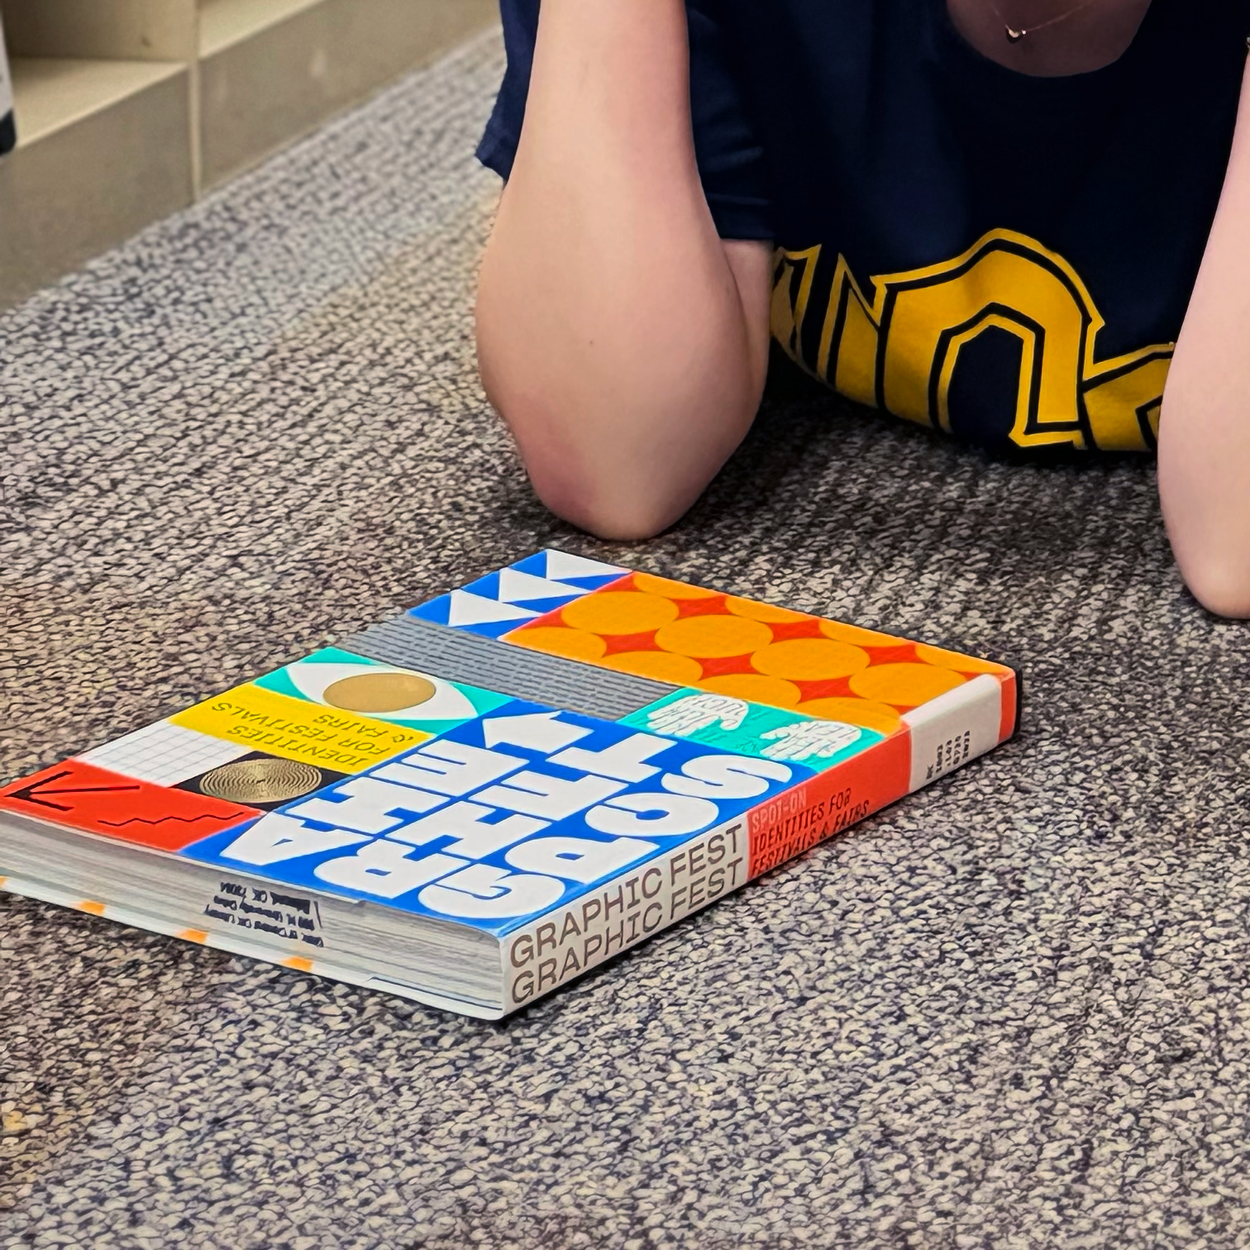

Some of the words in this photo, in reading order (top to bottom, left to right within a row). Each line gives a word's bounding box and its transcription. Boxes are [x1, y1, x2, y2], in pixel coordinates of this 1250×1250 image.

[211, 701, 337, 742] FESTIVALS
[226, 725, 370, 767] IDENTITIES
[312, 713, 390, 740] FAIRS
[337, 735, 391, 756] FOR
[752, 800, 826, 855] IDENTITIES
[828, 787, 853, 816] FOR
[752, 832, 816, 877] FESTIVALS
[832, 799, 870, 834] FAIRS
[509, 867, 664, 969] GRAPHIC
[669, 822, 744, 888] FEST
[511, 901, 664, 1006] GRAPHIC
[669, 856, 744, 920] FEST
